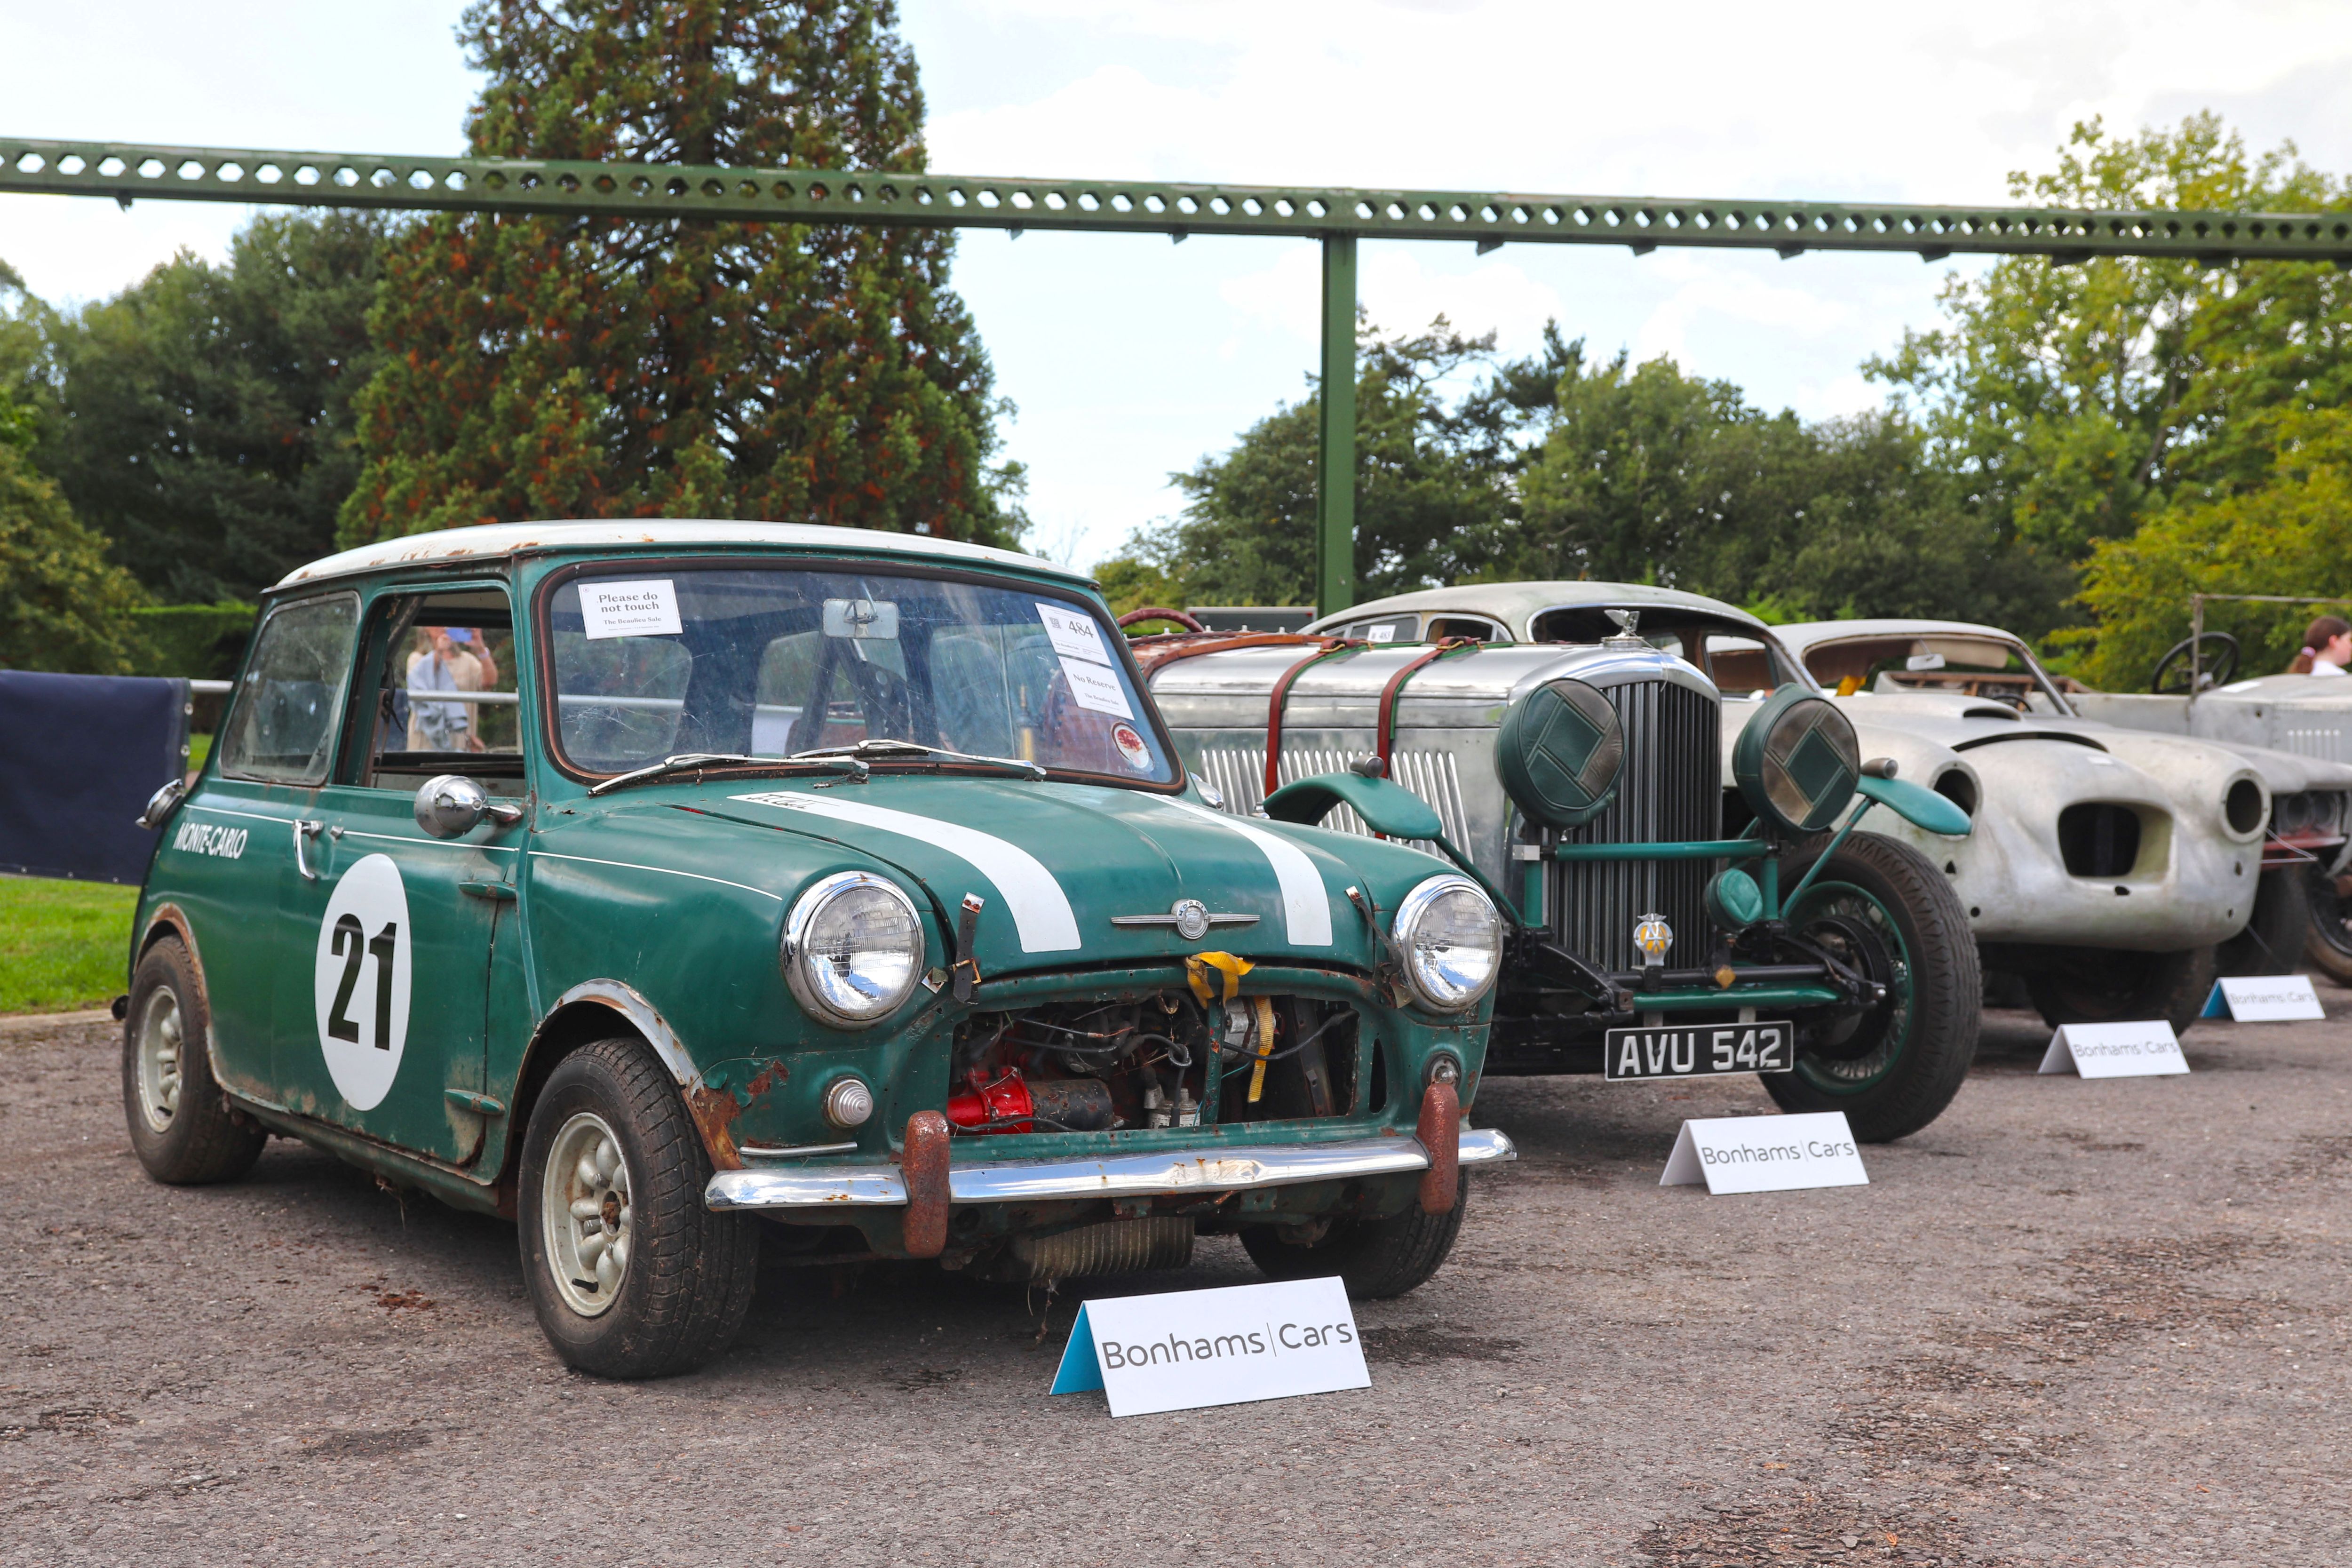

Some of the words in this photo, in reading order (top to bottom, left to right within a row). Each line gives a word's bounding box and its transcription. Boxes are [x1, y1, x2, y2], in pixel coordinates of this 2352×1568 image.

[599, 594, 639, 603] Please
[643, 592, 658, 600] do
[601, 604, 621, 613] not
[625, 601, 660, 611] touch
[1068, 621, 1094, 638] 484
[1073, 673, 1086, 683] No
[1086, 676, 1116, 691] Reserve
[173, 822, 248, 860] MONTE-CARLO
[328, 913, 397, 1051] 21
[1618, 1033, 1694, 1075] AVU
[1712, 1028, 1781, 1071] 542
[2074, 1042, 2141, 1058] Bonhams
[2145, 1041, 2179, 1054] Cars
[1701, 1144, 1801, 1164] Bonhams
[1808, 1141, 1854, 1158] Cars
[1102, 1333, 1265, 1369] Bonhams
[1279, 1323, 1352, 1349] Cars
